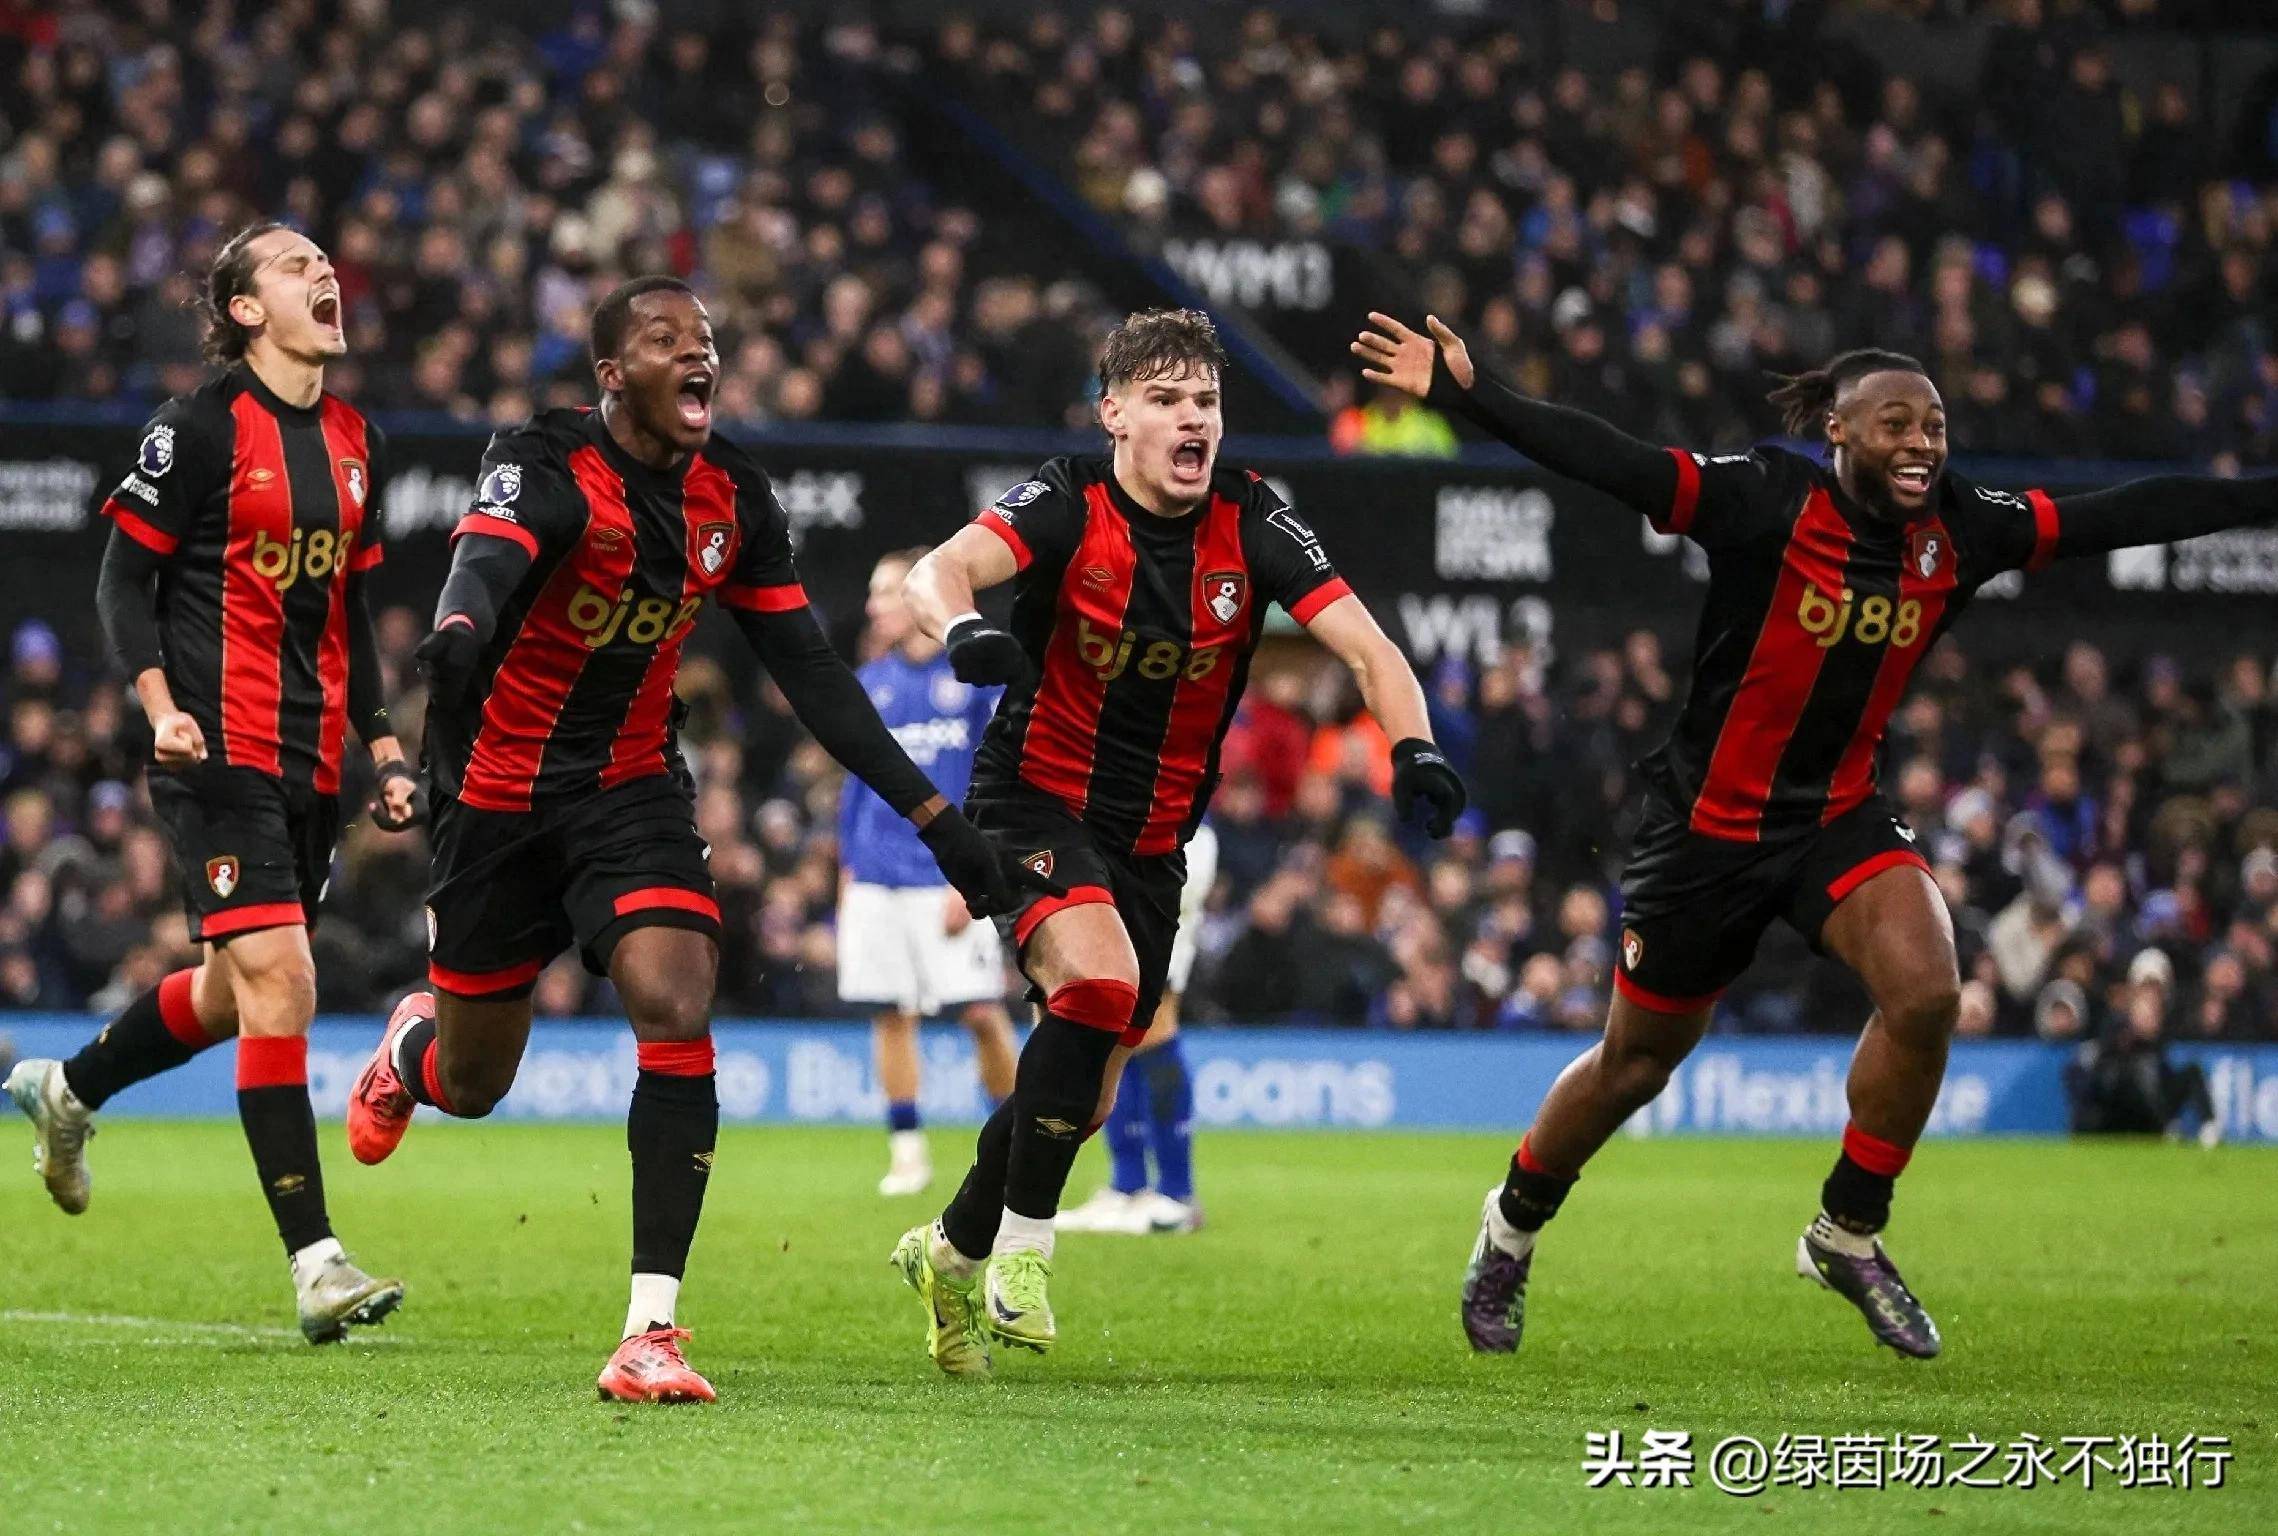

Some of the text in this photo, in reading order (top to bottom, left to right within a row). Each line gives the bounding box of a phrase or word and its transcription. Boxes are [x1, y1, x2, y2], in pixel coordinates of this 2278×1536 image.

[1797, 583, 1922, 648] bj88
[1078, 616, 1222, 681] bj88
[1191, 1059, 1396, 1125] oans
